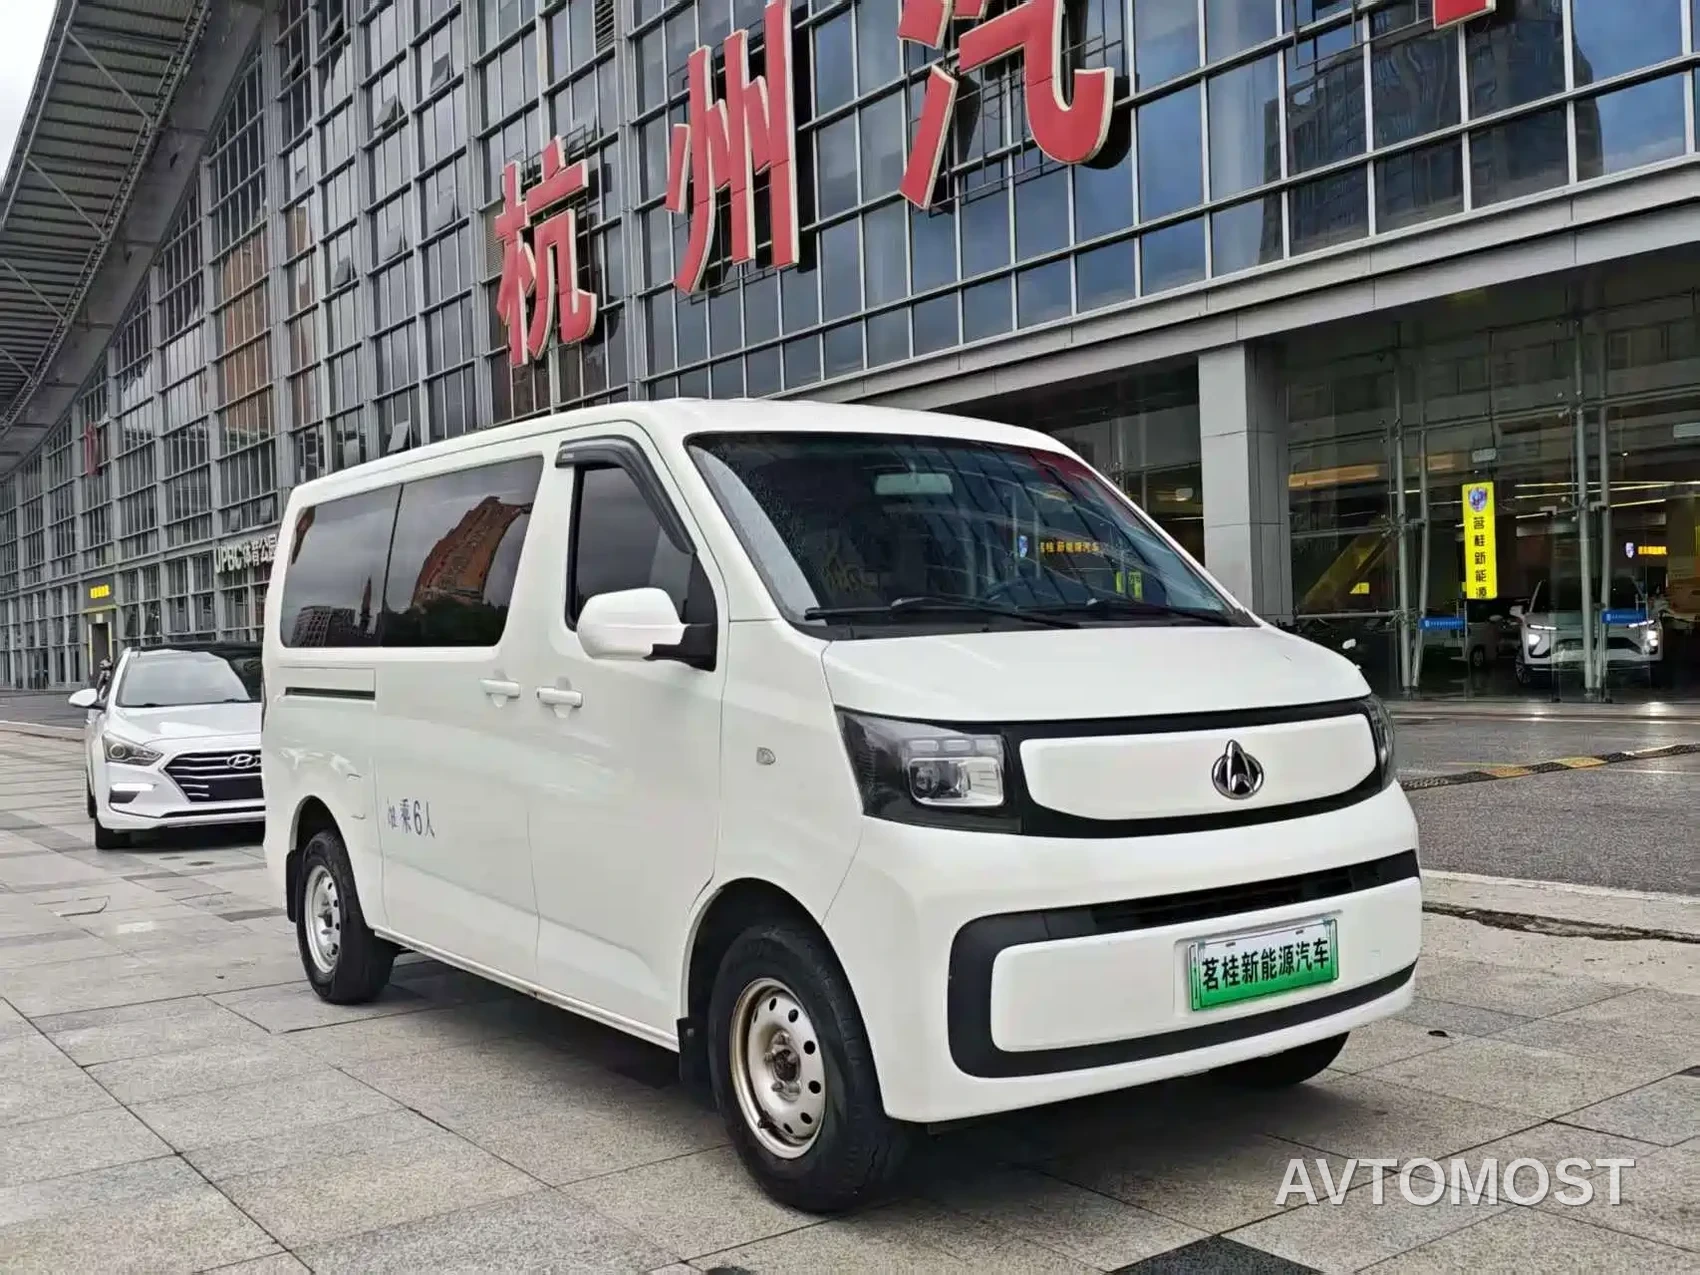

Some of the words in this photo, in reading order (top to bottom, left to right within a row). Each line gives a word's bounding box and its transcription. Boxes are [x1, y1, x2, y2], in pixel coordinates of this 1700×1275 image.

[1201, 937, 1330, 992] 茗桂新能源汽车
